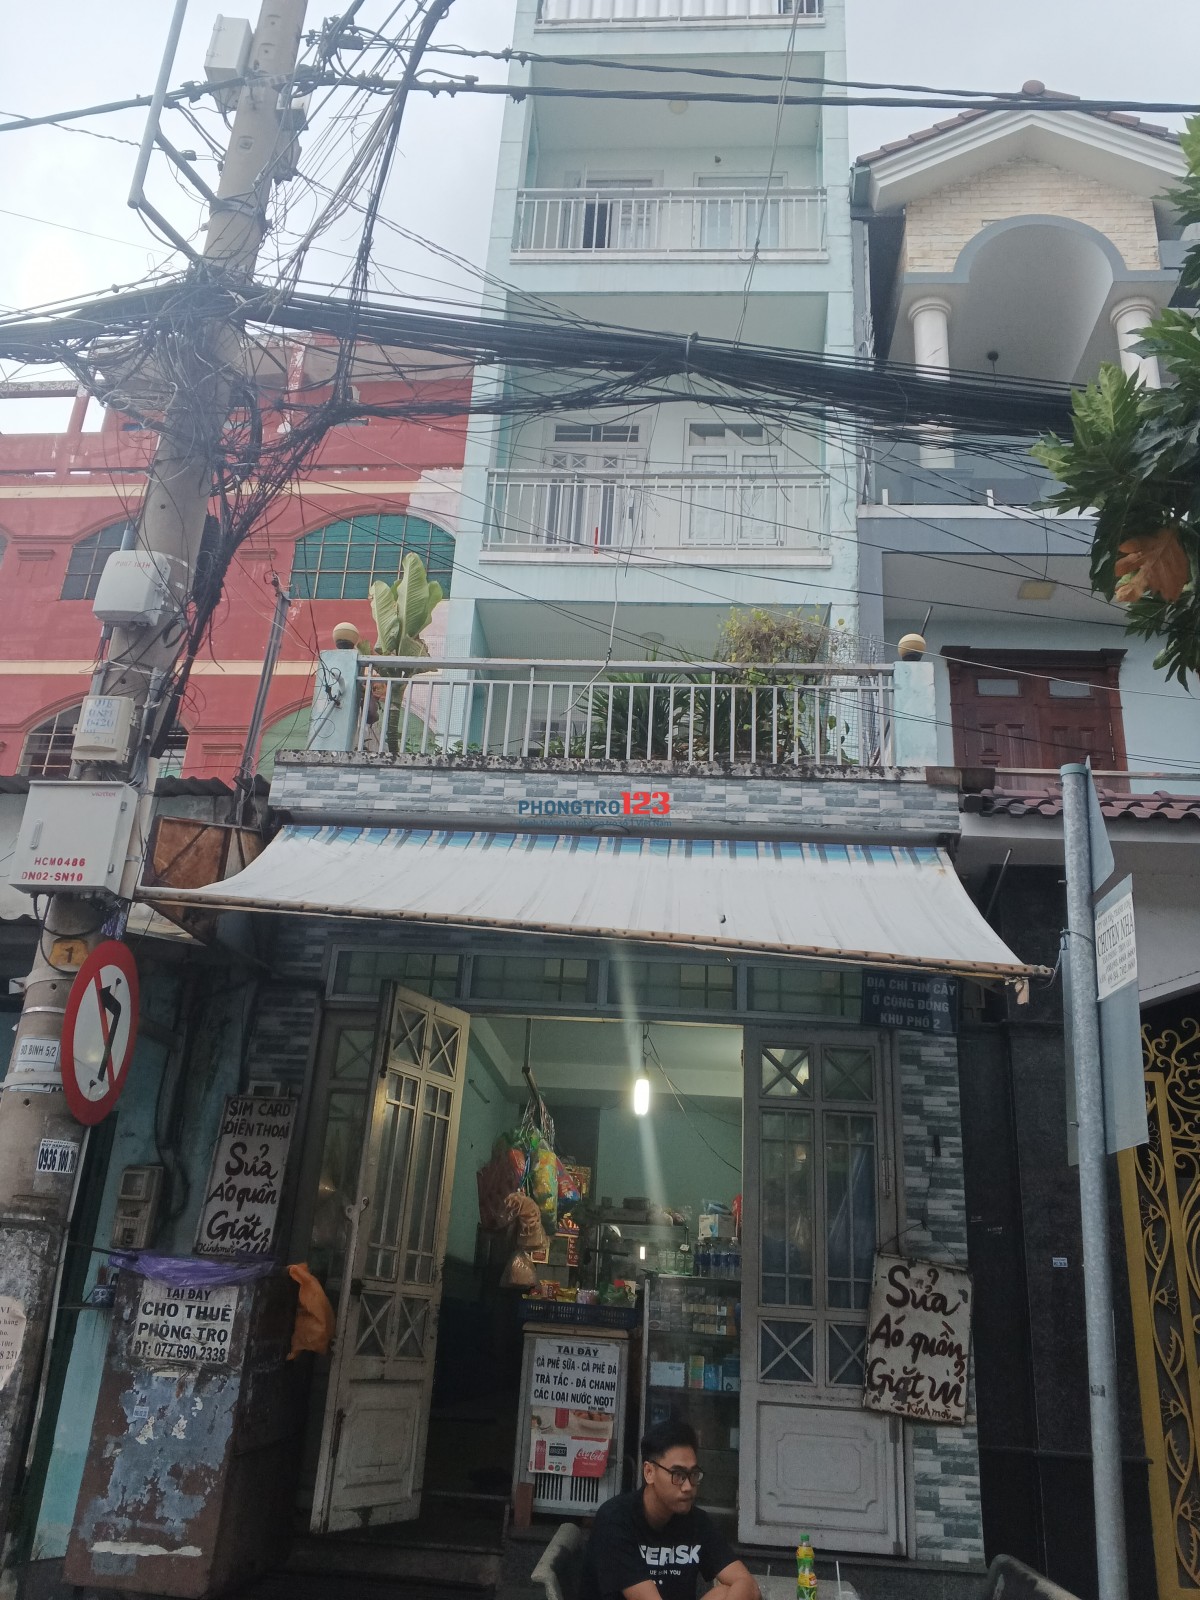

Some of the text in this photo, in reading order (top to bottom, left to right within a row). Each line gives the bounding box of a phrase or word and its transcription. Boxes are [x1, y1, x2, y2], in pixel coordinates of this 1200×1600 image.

[34, 857, 86, 867] HCM0486
[21, 872, 84, 882] DN02-SN10
[65, 946, 73, 963] 1
[911, 981, 930, 993] TIN
[880, 1012, 904, 1025] KHU
[933, 1018, 941, 1029] 2
[229, 1101, 291, 1117] SIM CARD
[142, 1301, 232, 1322] CHO THUÊ
[138, 1320, 228, 1345] PHÒNG TRỌ
[547, 1356, 560, 1369] PHÊ
[562, 1357, 576, 1371] SỮA
[592, 1361, 606, 1374] PHÊ
[607, 1363, 617, 1375] ĐÁ
[535, 1372, 550, 1385] TRÀ
[553, 1372, 569, 1386] TẮC
[575, 1376, 587, 1388] ĐÁ
[589, 1379, 616, 1391] CHANH
[534, 1387, 614, 1409] CÁC LOẠI NƯỚC NGỌT
